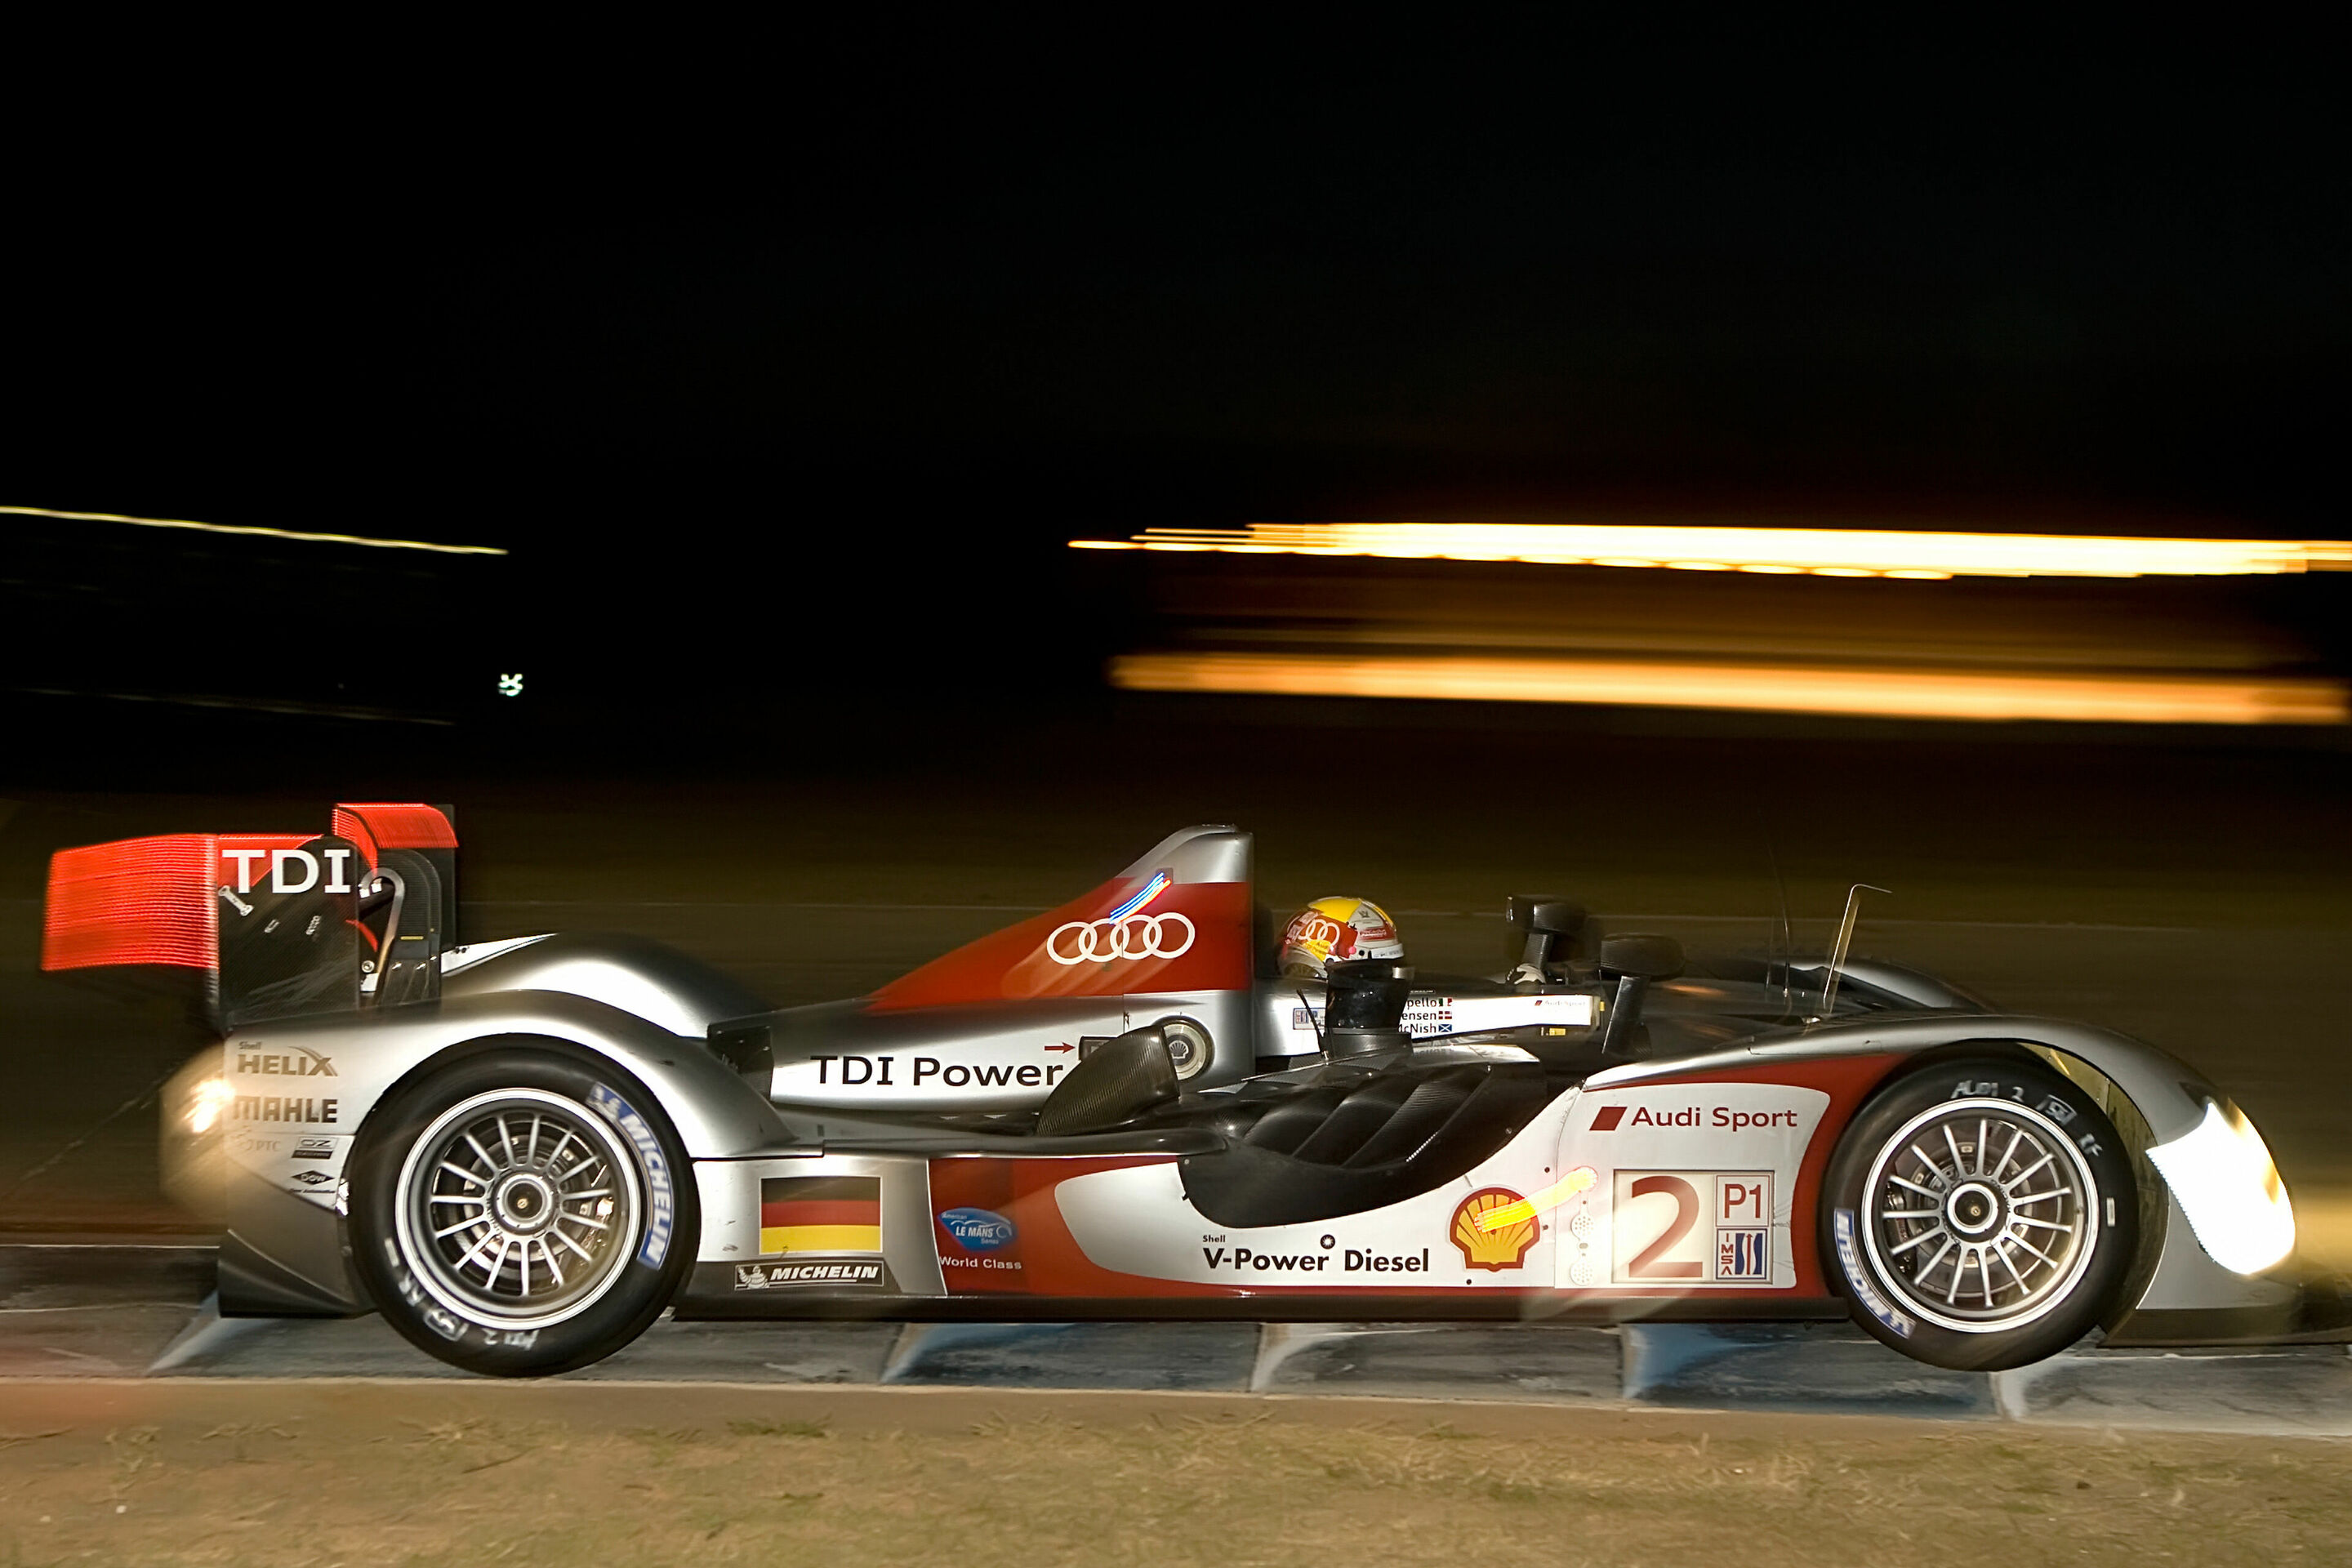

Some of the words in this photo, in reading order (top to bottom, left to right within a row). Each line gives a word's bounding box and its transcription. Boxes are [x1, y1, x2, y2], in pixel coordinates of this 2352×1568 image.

[222, 849, 350, 893] TDI
[238, 1041, 261, 1050] Shell
[237, 1052, 336, 1076] HELIX
[810, 1055, 893, 1085] TDI
[913, 1057, 1063, 1087] Power
[233, 1095, 337, 1123] MAHLE
[1631, 1107, 1700, 1127] Audi
[1712, 1107, 1797, 1132] Sport
[618, 1112, 672, 1263] MICHELIN
[1724, 1183, 1761, 1218] P1
[956, 1226, 966, 1236] LE
[968, 1227, 994, 1238] MANS
[1203, 1235, 1226, 1243] Shell
[1628, 1175, 1704, 1278] 2
[939, 1256, 978, 1267] World
[982, 1258, 1022, 1270] Class
[1203, 1247, 1330, 1271] V-Power
[1344, 1248, 1429, 1272] Diesel
[1721, 1233, 1734, 1276] IMSA
[770, 1265, 879, 1281] MICHELIN
